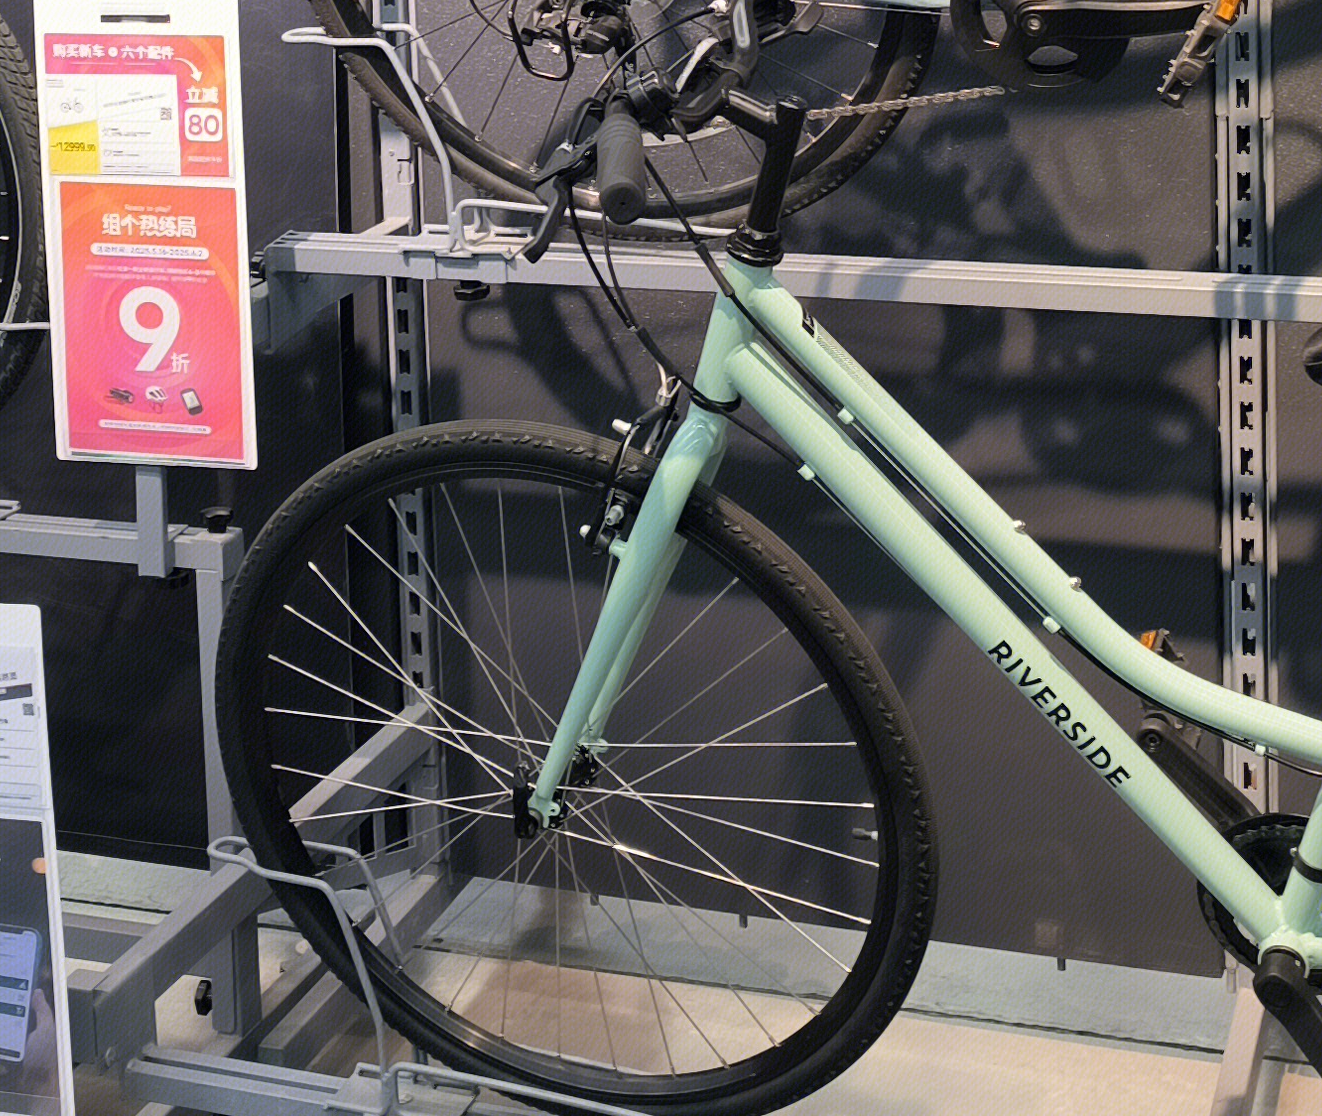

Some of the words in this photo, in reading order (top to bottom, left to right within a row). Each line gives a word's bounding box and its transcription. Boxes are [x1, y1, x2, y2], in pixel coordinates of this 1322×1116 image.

[52, 43, 106, 59] 购买新车
[120, 45, 175, 61] 六个配件
[183, 86, 219, 104] 立减
[187, 114, 220, 136] 80
[987, 639, 1131, 789] RIVERSIDE
